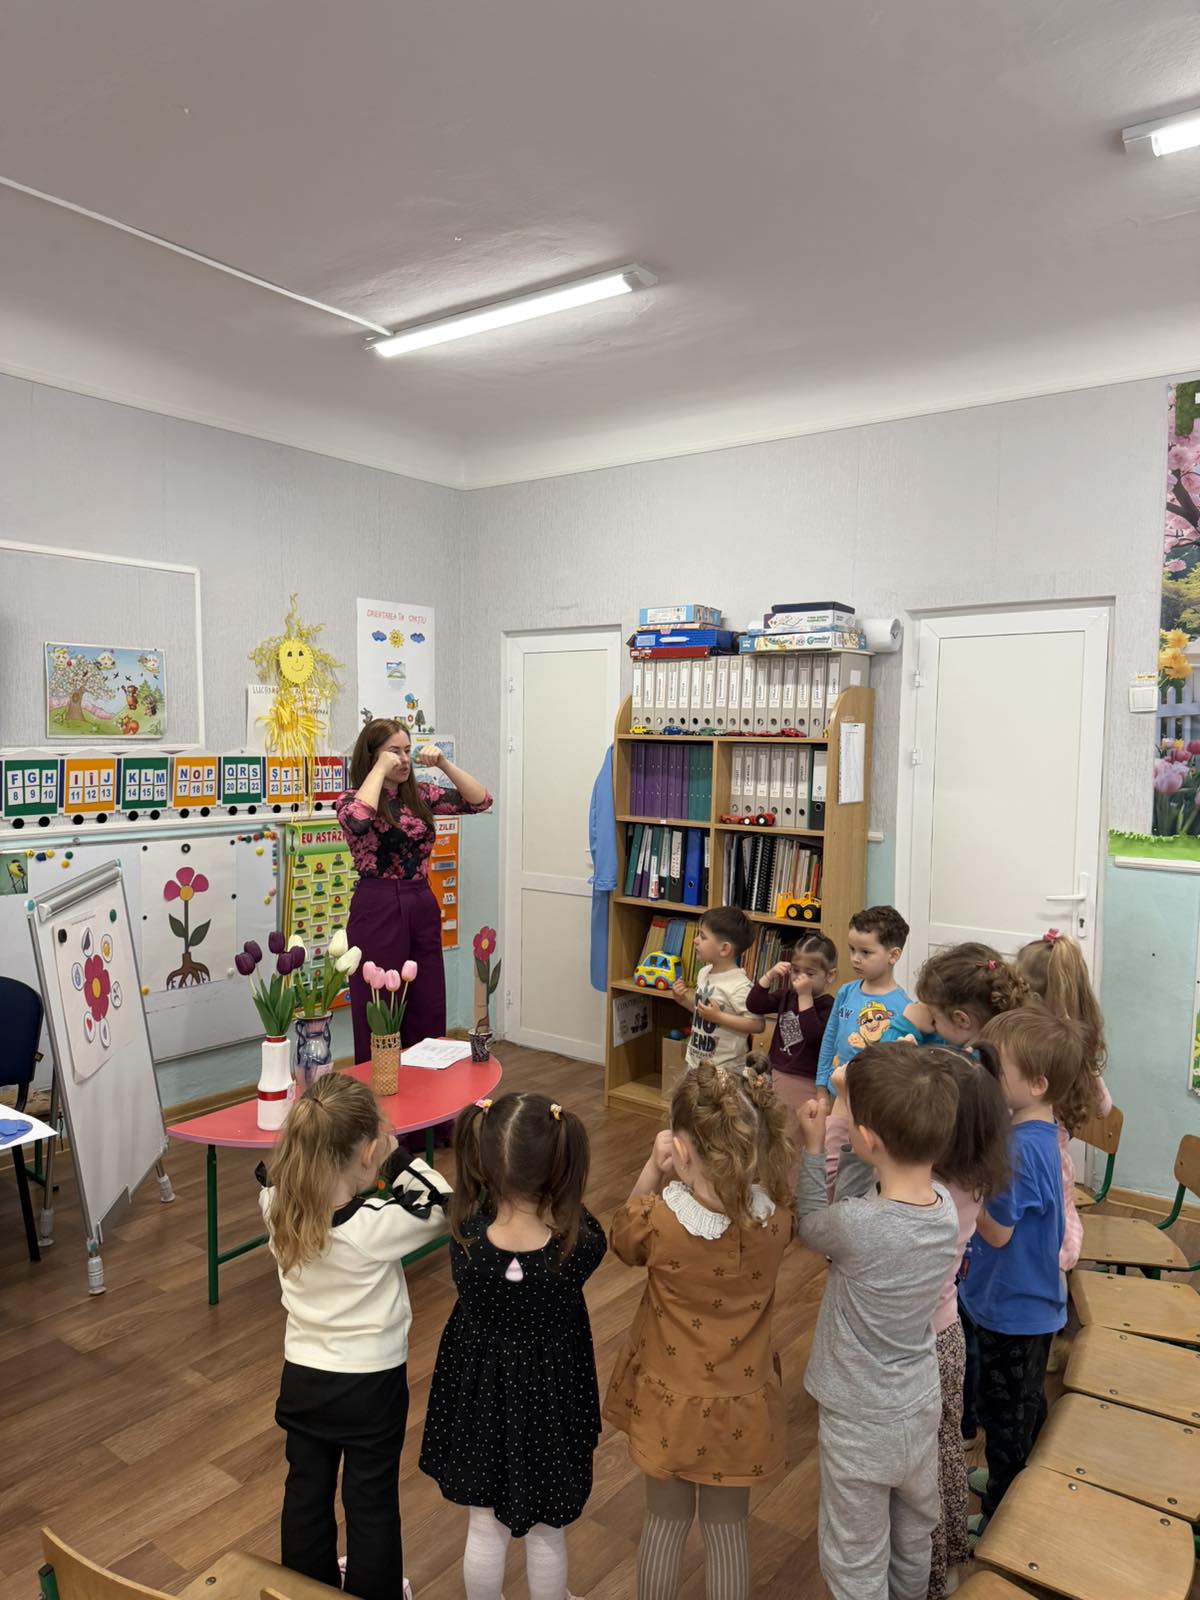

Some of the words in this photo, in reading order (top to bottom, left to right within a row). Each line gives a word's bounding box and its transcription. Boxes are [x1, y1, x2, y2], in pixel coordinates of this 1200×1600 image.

[180, 769, 188, 778] N
[193, 770, 201, 779] O
[207, 769, 213, 778] P
[227, 767, 235, 777] Q
[240, 767, 247, 776] R
[251, 767, 258, 777] S
[324, 768, 330, 777] V
[334, 768, 342, 777] W
[11, 774, 19, 784] F
[27, 773, 37, 783] G
[45, 773, 54, 783] H
[103, 772, 111, 783] J
[129, 773, 137, 783] K
[144, 772, 151, 782] L
[156, 773, 165, 783] M
[178, 784, 187, 793] 17
[192, 785, 201, 794] 18
[205, 783, 213, 792] 19
[226, 782, 235, 791] 20
[239, 781, 247, 790] 21
[251, 782, 259, 791] 22
[271, 784, 279, 792] 23
[283, 784, 291, 792] 24
[13, 791, 19, 800] 8
[30, 790, 36, 798] 9
[43, 790, 54, 799] 10
[71, 791, 80, 800] 11
[87, 789, 96, 799] 12
[101, 789, 111, 798] 13
[128, 789, 137, 797] 14
[142, 788, 151, 796] 15
[156, 789, 165, 797] 16
[301, 832, 313, 844] EU
